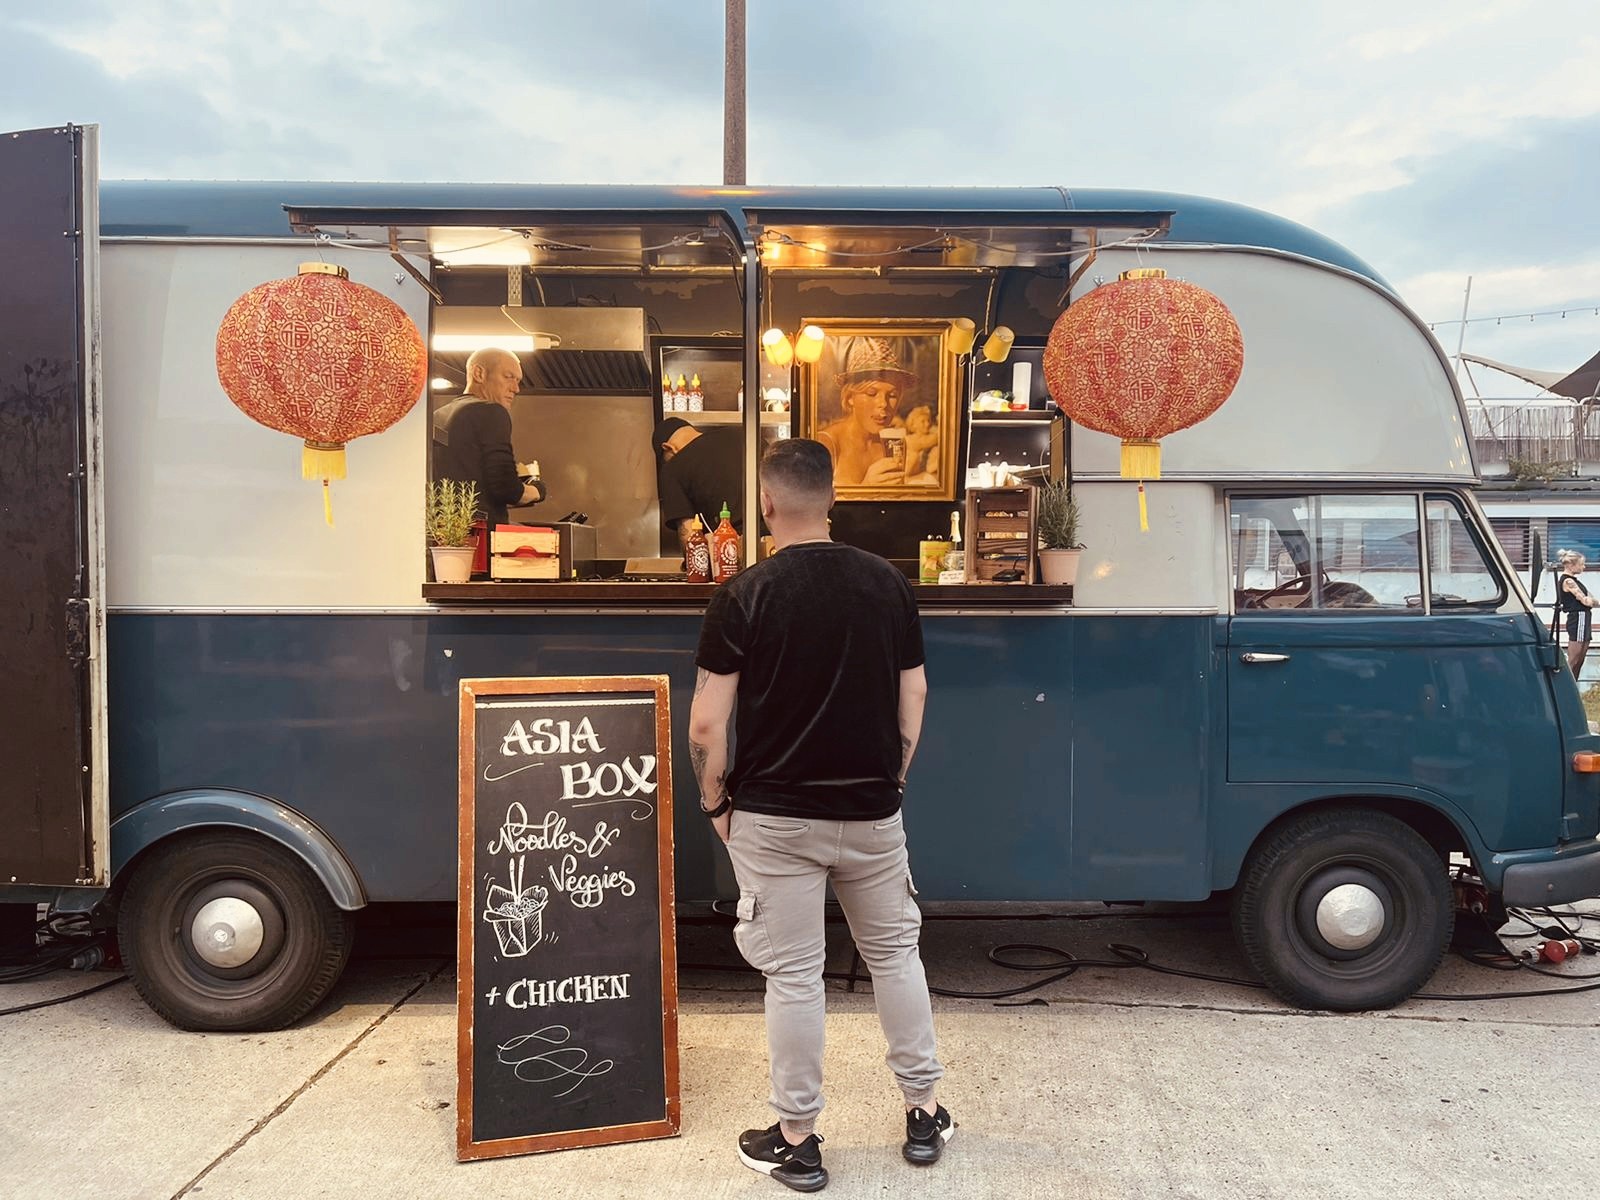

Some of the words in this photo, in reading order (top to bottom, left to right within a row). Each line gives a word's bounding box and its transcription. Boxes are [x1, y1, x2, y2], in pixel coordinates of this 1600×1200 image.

[1127, 308, 1155, 331] 福
[1180, 314, 1206, 340] 福
[281, 321, 310, 349] 福
[358, 332, 384, 359] 福
[241, 351, 265, 378] 福
[320, 365, 348, 391] 福
[1129, 379, 1156, 402] 福
[500, 716, 606, 756] ASIA
[559, 755, 657, 800] BOX
[487, 802, 587, 855] Noodles
[588, 821, 620, 858] &
[548, 853, 636, 908] Veggies
[505, 973, 631, 1010] CHICKEN
